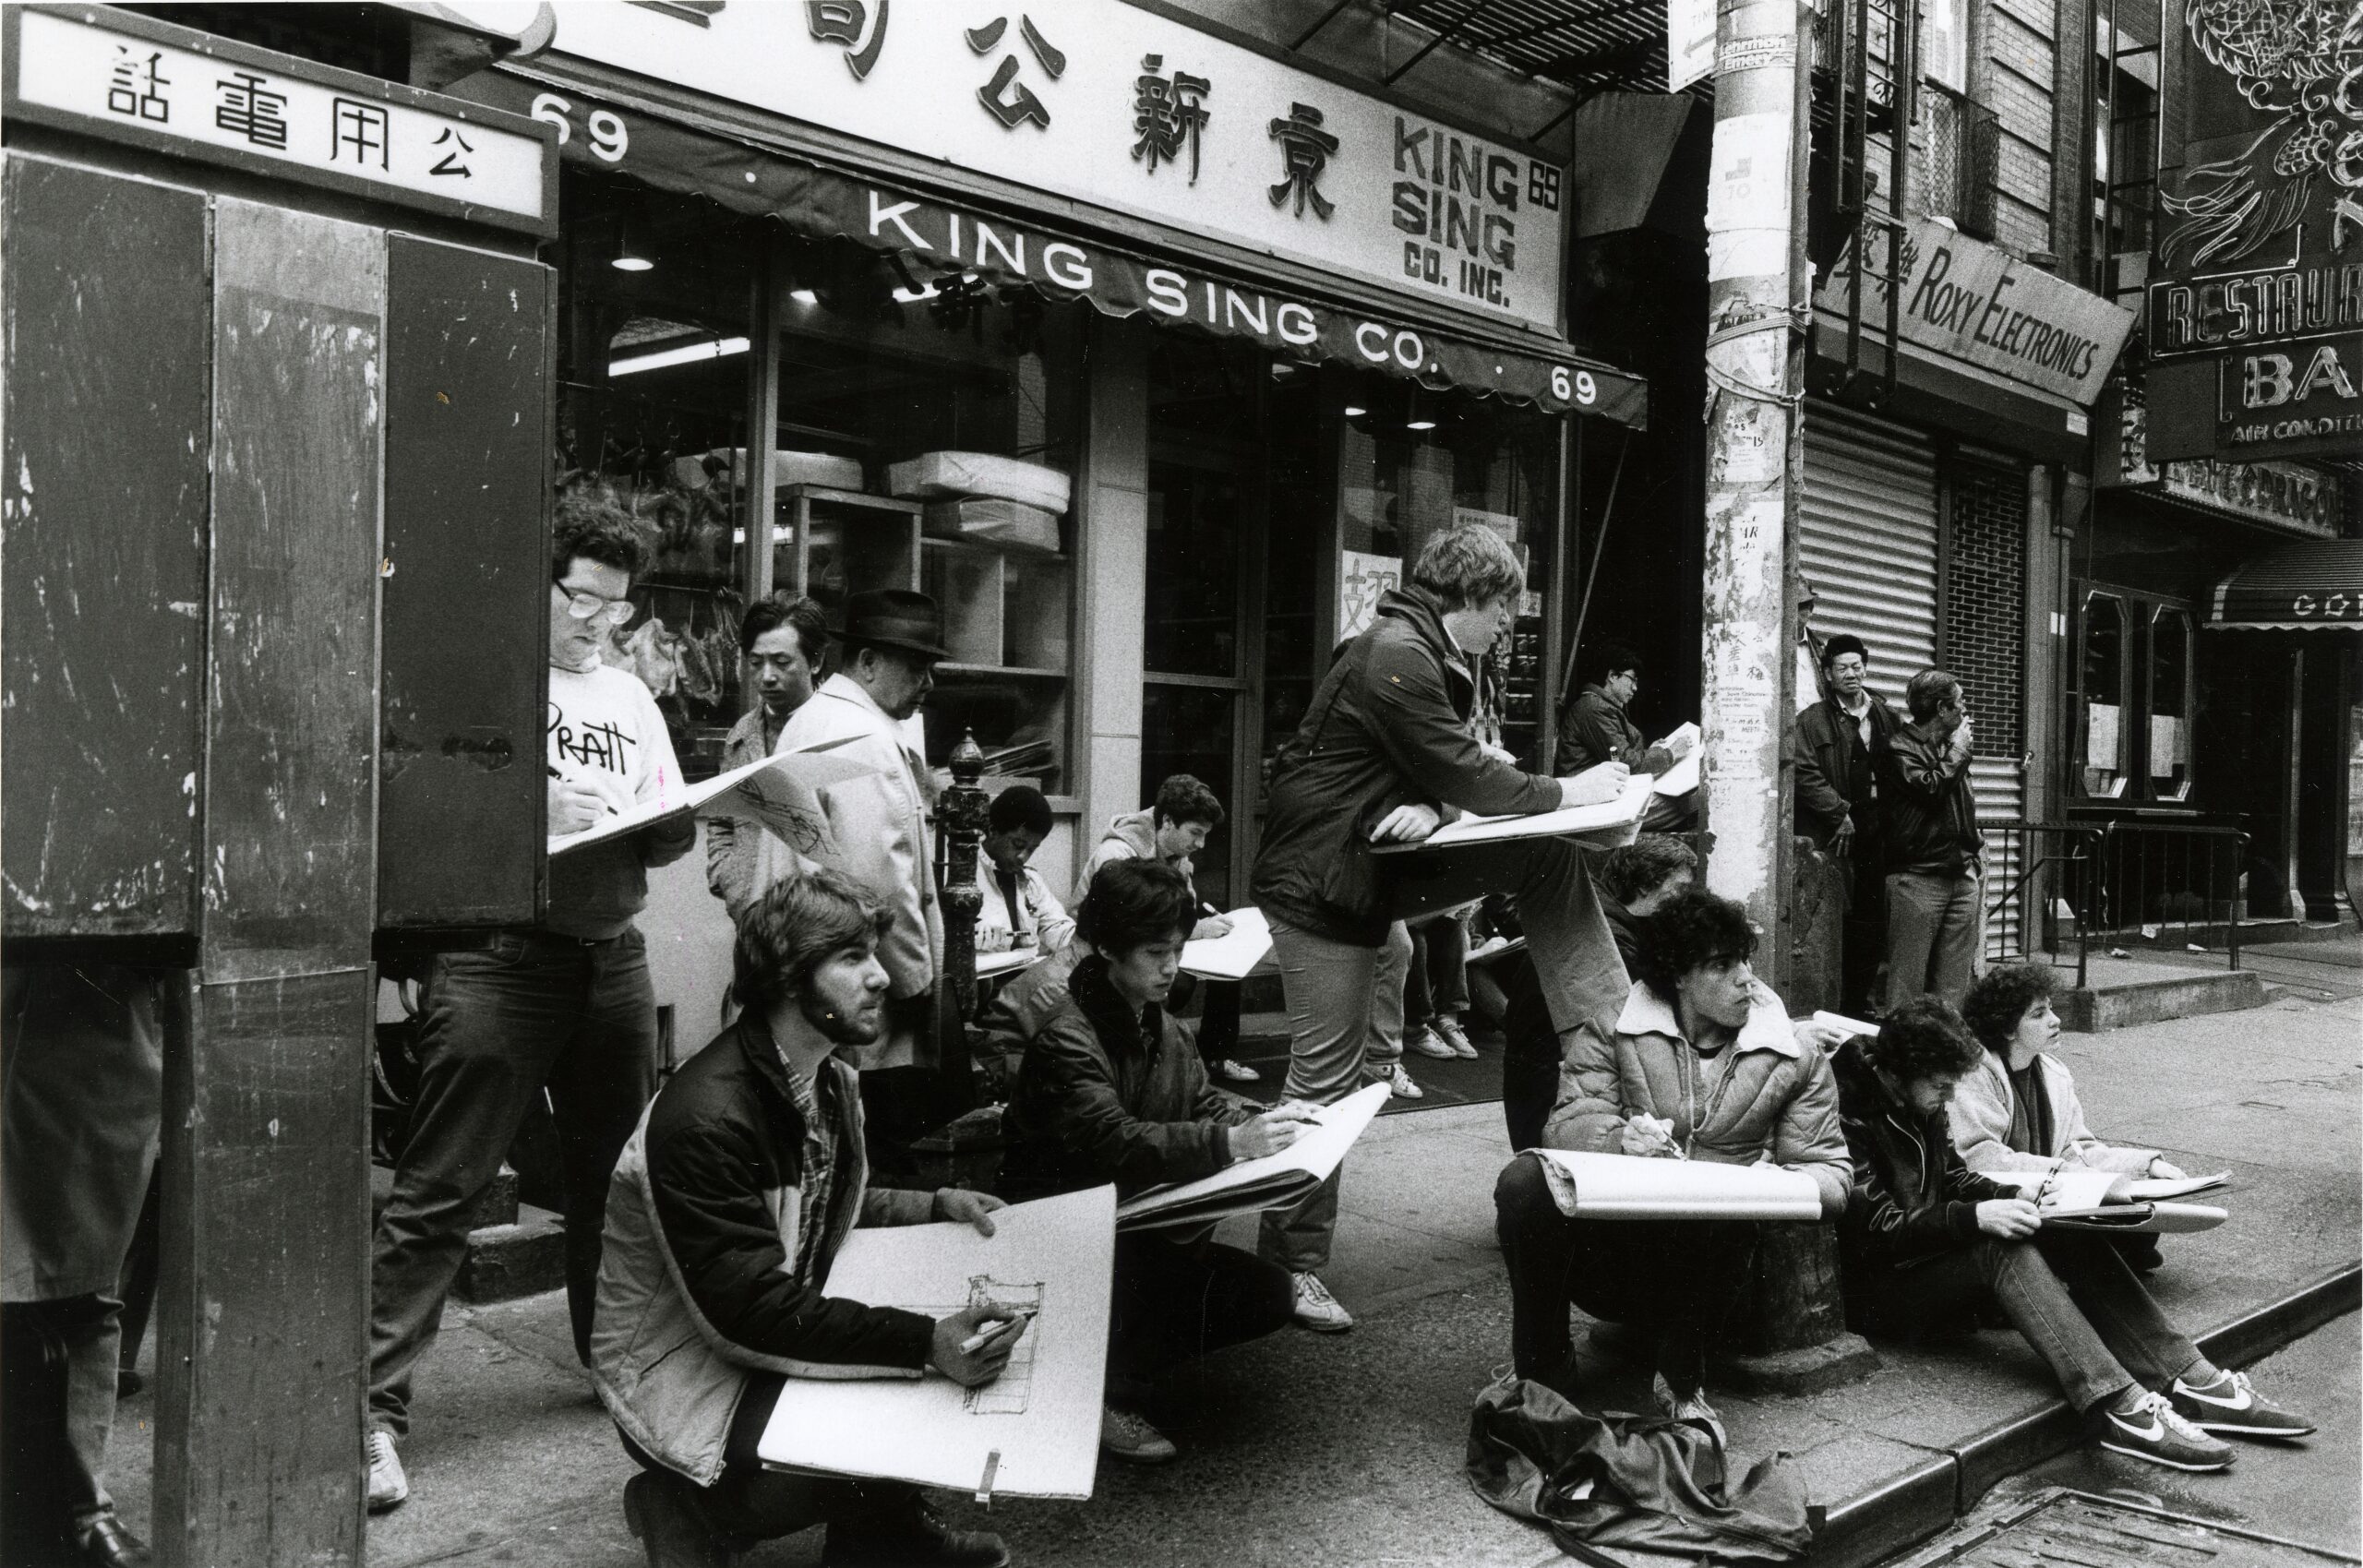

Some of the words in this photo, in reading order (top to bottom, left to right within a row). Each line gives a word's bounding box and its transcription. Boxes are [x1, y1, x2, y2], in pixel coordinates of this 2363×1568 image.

[1724, 51, 1772, 71] Emery
[1394, 115, 1518, 211] KING
[1528, 160, 1561, 211] 69
[531, 93, 629, 162] 69
[869, 190, 1093, 291] KING
[1146, 269, 1319, 346] SING
[1355, 322, 1438, 373] CO.
[1551, 366, 1597, 405] 69
[1392, 182, 1516, 270] SING
[1404, 241, 1448, 287] CO.
[1459, 259, 1510, 308] INC.
[2244, 345, 2363, 408] BA
[2230, 424, 2269, 443] AIR
[2273, 413, 2363, 440] CONDITI
[2293, 592, 2363, 616] GO
